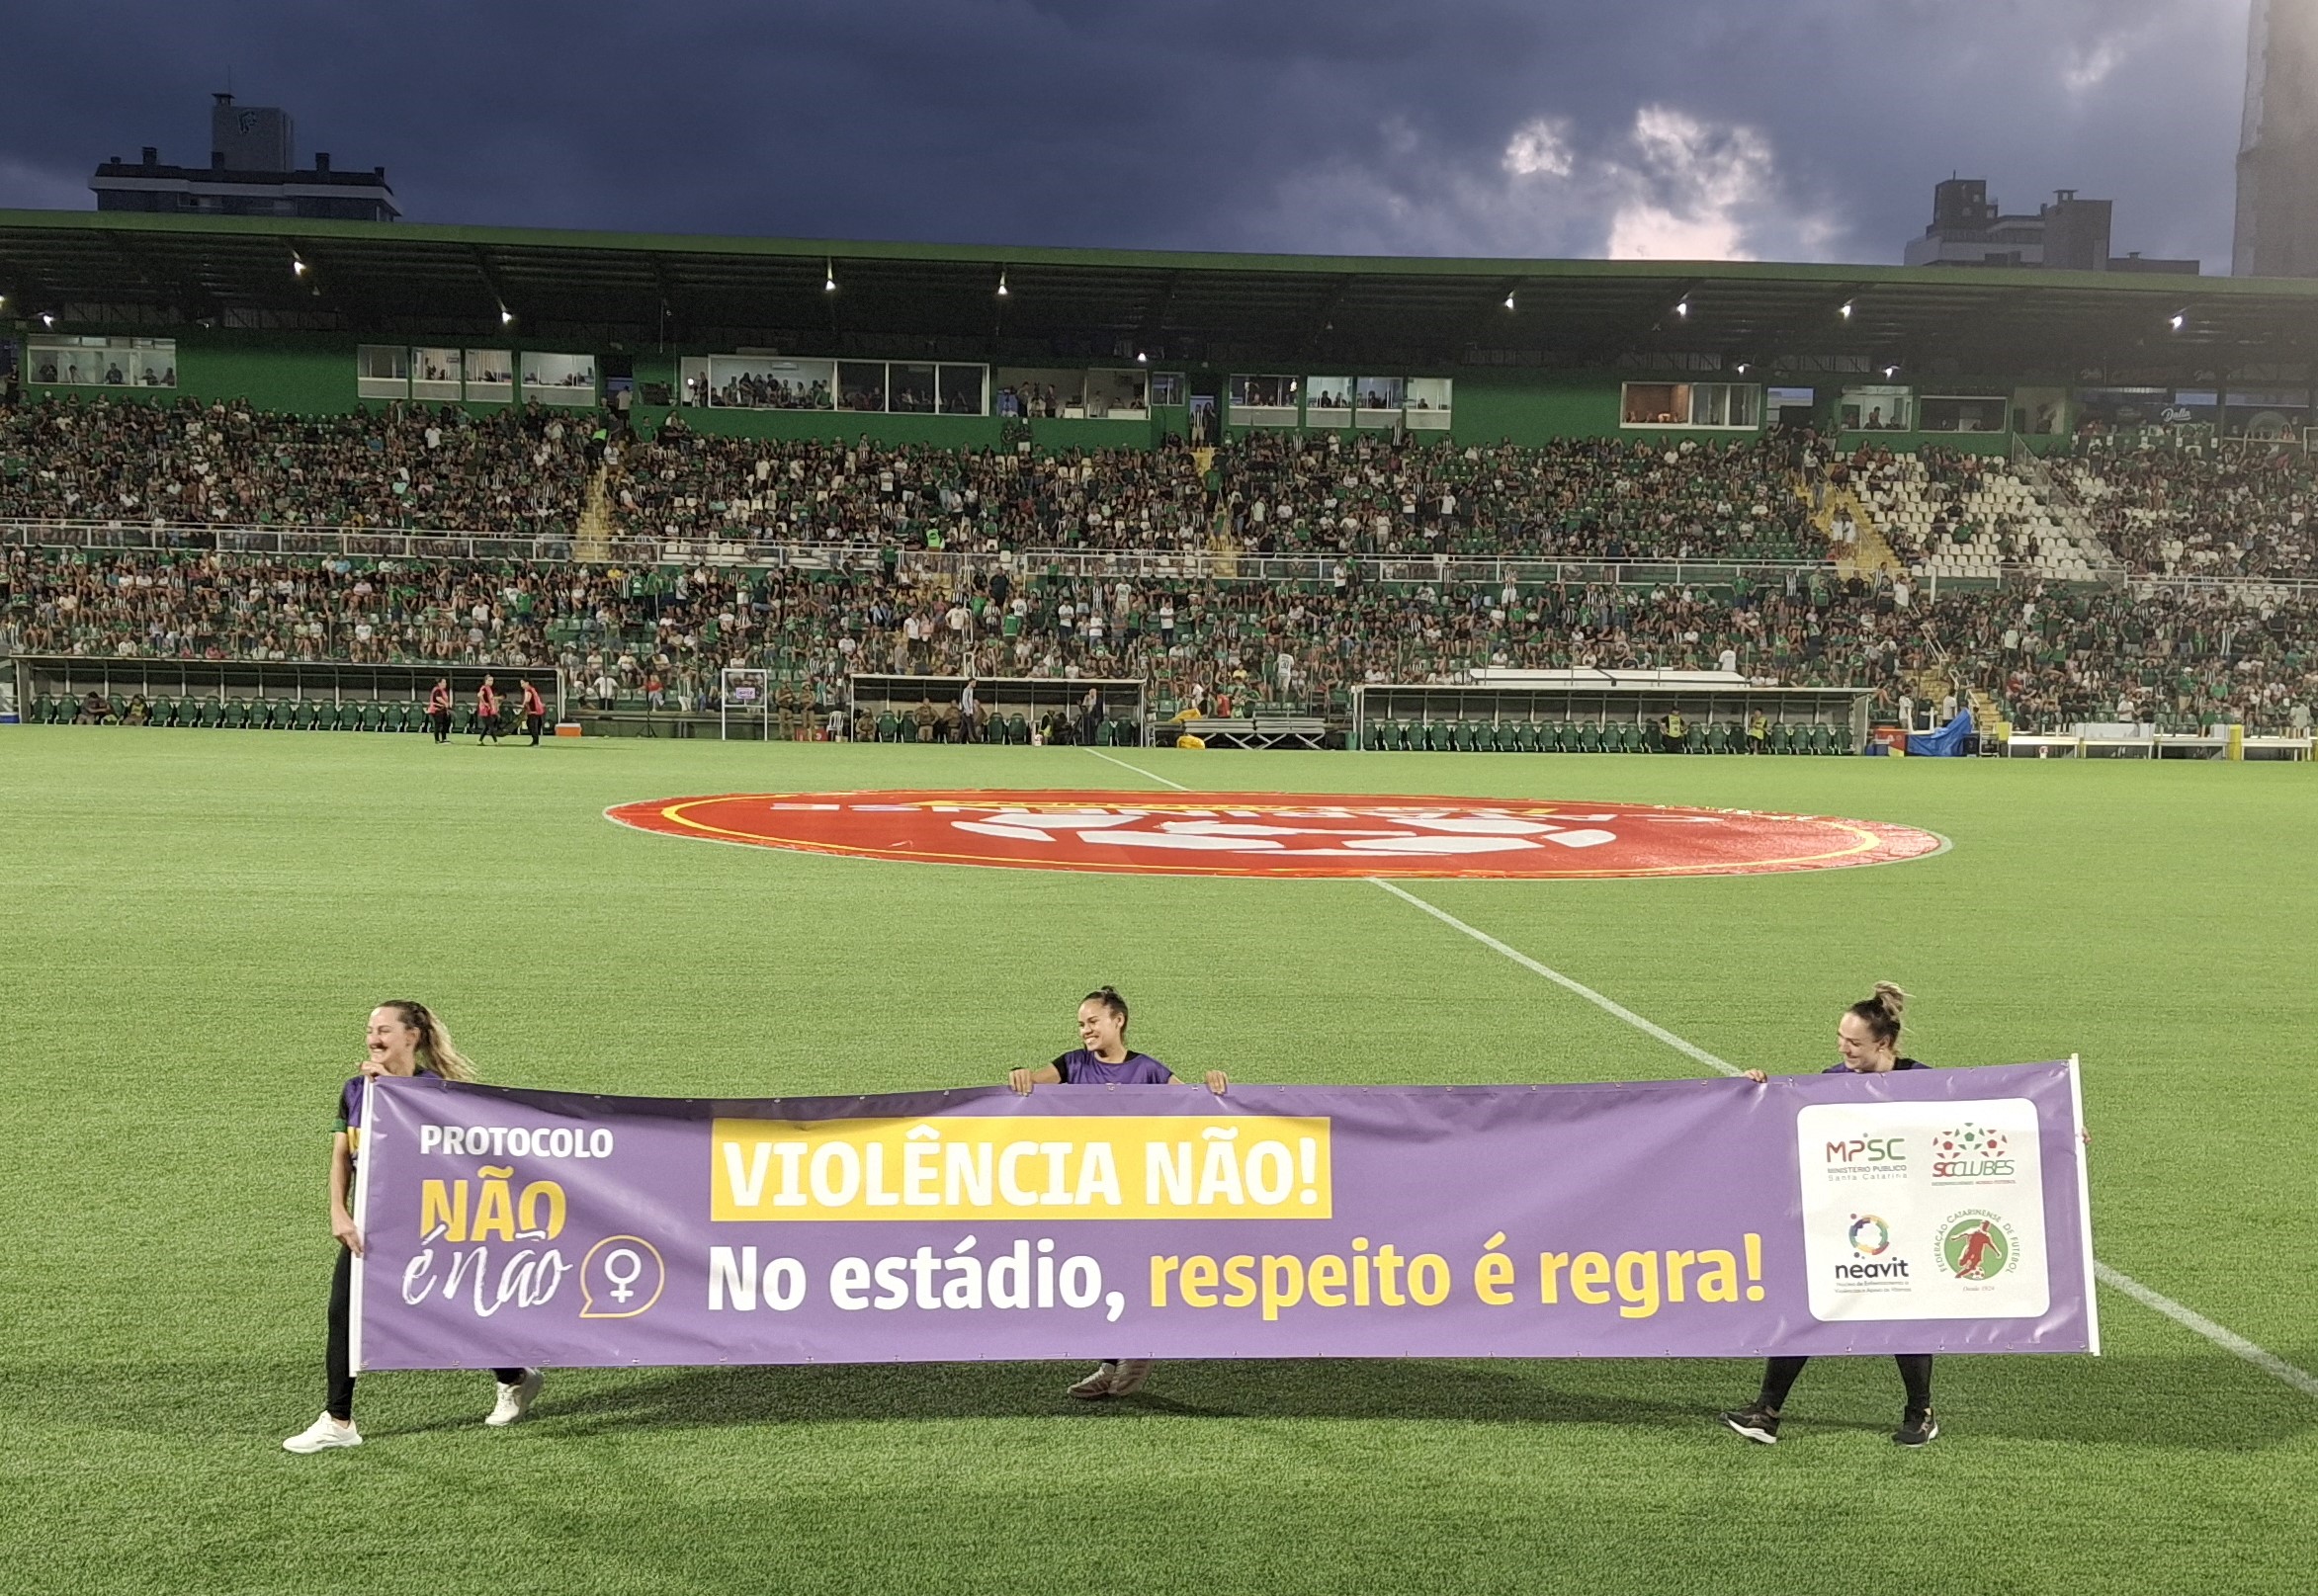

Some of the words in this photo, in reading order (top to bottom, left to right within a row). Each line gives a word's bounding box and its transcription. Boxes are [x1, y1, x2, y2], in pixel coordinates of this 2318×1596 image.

[420, 1125, 614, 1158] PROTOCOLO
[723, 1124, 1122, 1207] VIOLÊNCIA
[1145, 1126, 1318, 1206] NÃO!
[1827, 1138, 1906, 1162] MPSC
[420, 1165, 567, 1242] NÃO
[707, 1245, 807, 1311] No
[829, 1234, 1126, 1323] estádio,
[1150, 1236, 1451, 1321] respeito
[1474, 1230, 1514, 1305] é
[1540, 1231, 1765, 1319] regra!
[1835, 1257, 1909, 1279] neavit
